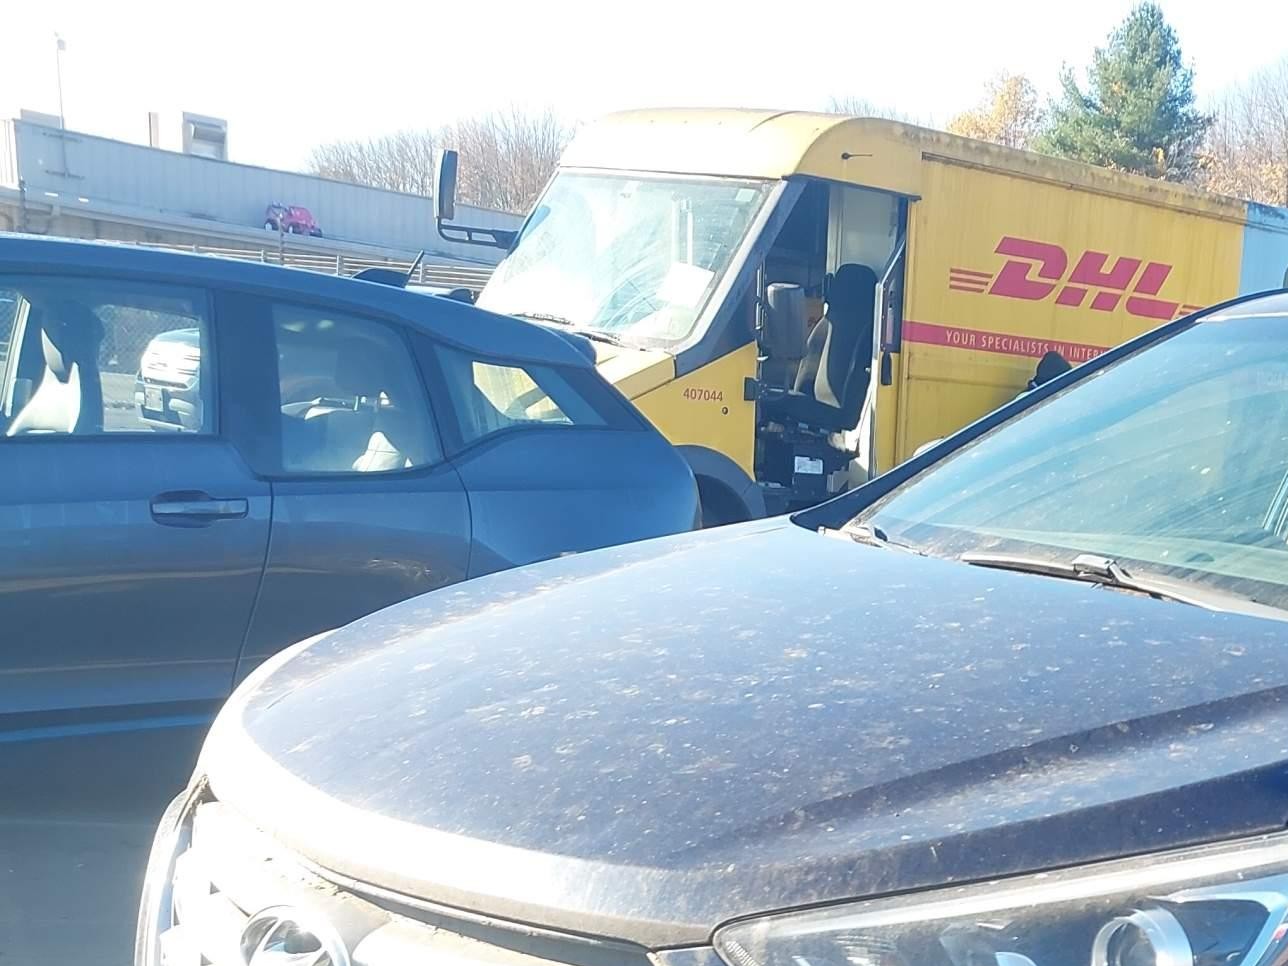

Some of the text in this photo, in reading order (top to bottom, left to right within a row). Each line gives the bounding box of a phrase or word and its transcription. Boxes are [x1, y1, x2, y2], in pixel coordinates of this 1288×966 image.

[989, 236, 1179, 320] DHL
[946, 330, 976, 346] YOUR
[981, 335, 1050, 355] SPECIALISTS
[683, 388, 723, 402] 407044
